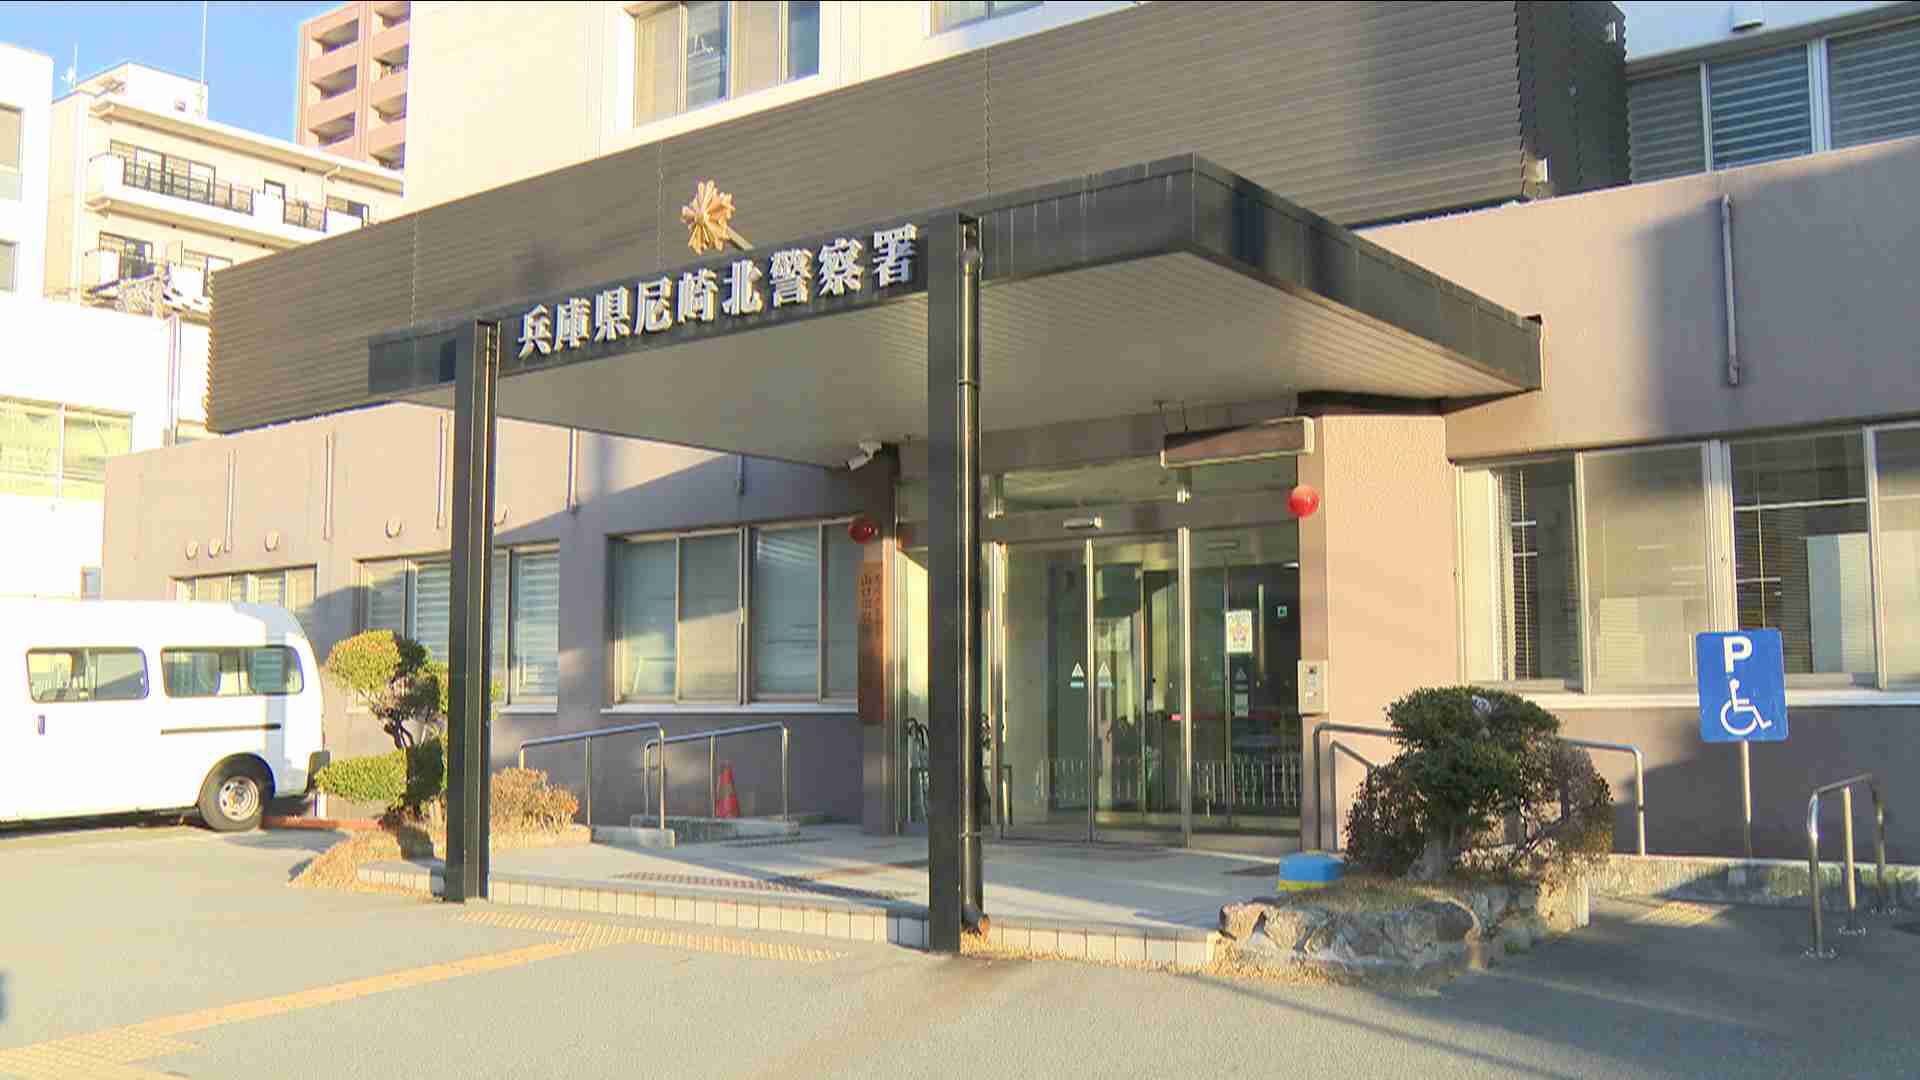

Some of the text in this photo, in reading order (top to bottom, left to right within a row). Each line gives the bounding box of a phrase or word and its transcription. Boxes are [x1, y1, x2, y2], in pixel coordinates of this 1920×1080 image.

[518, 223, 918, 358] 兵庫県尼崎北警察署
[1723, 635, 1753, 673] P
